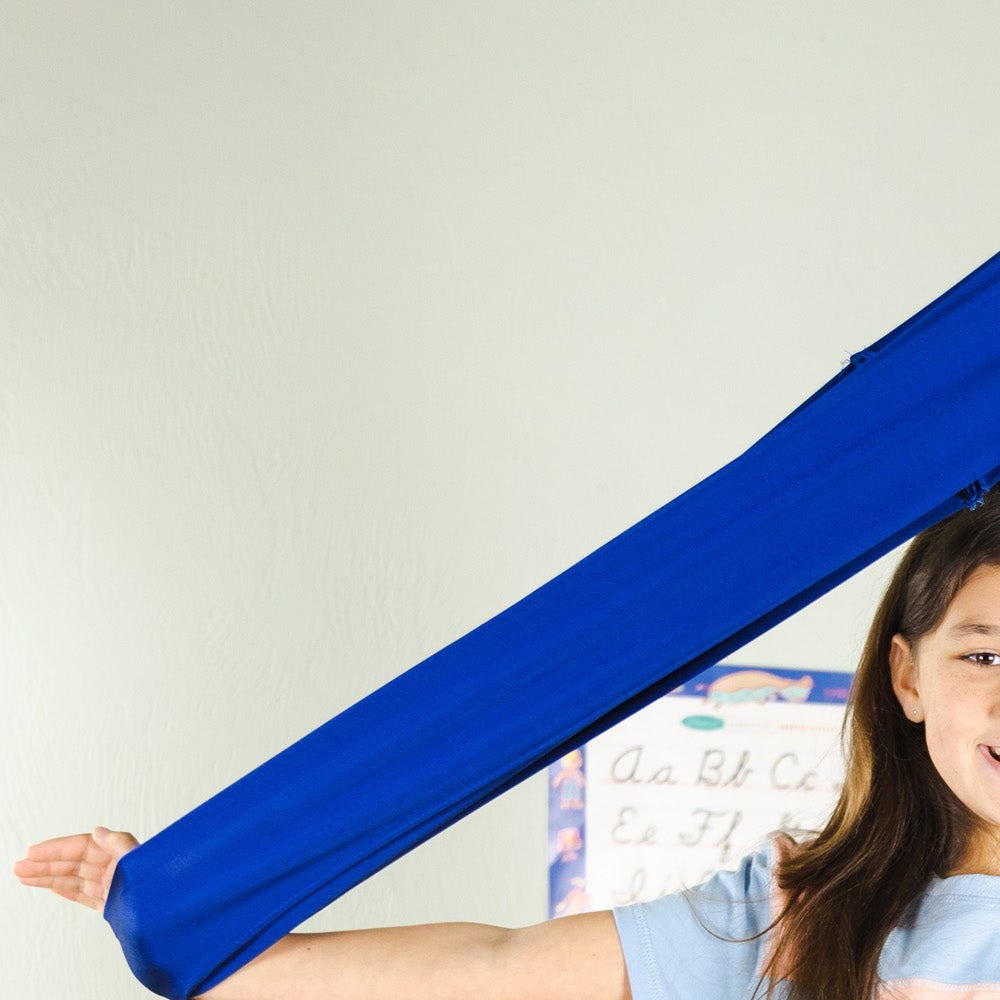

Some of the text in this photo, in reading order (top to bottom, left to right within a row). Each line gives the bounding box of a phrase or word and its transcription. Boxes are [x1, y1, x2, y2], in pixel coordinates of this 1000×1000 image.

[610, 745, 816, 791] Aa Bb Cc
[610, 805, 659, 845] Ee
[677, 808, 743, 863] Ff
